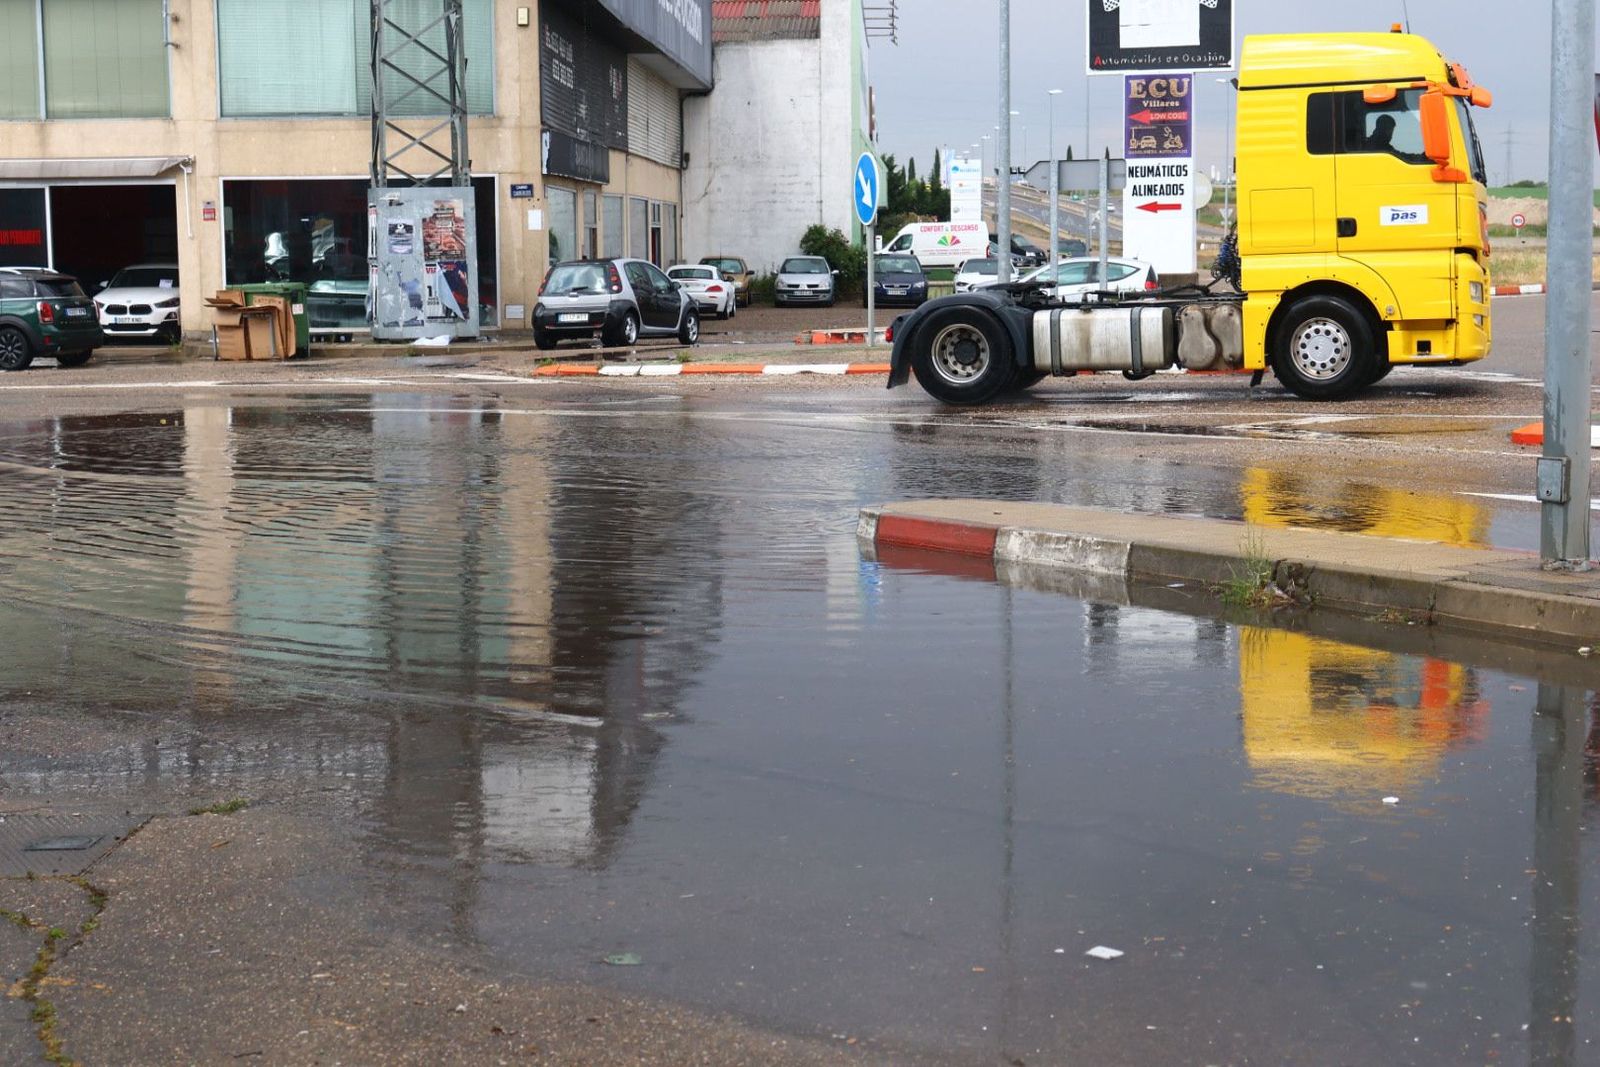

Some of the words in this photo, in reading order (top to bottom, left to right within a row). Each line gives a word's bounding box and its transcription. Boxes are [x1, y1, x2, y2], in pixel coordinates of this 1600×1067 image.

[1128, 78, 1190, 98] ECU
[1142, 100, 1180, 108] Villares
[1150, 112, 1167, 120] LOW
[1128, 162, 1188, 178] NEUMÁTICOS
[1131, 183, 1184, 197] ALINEADOS
[1390, 211, 1417, 222] pas
[951, 224, 979, 232] DESCANSO
